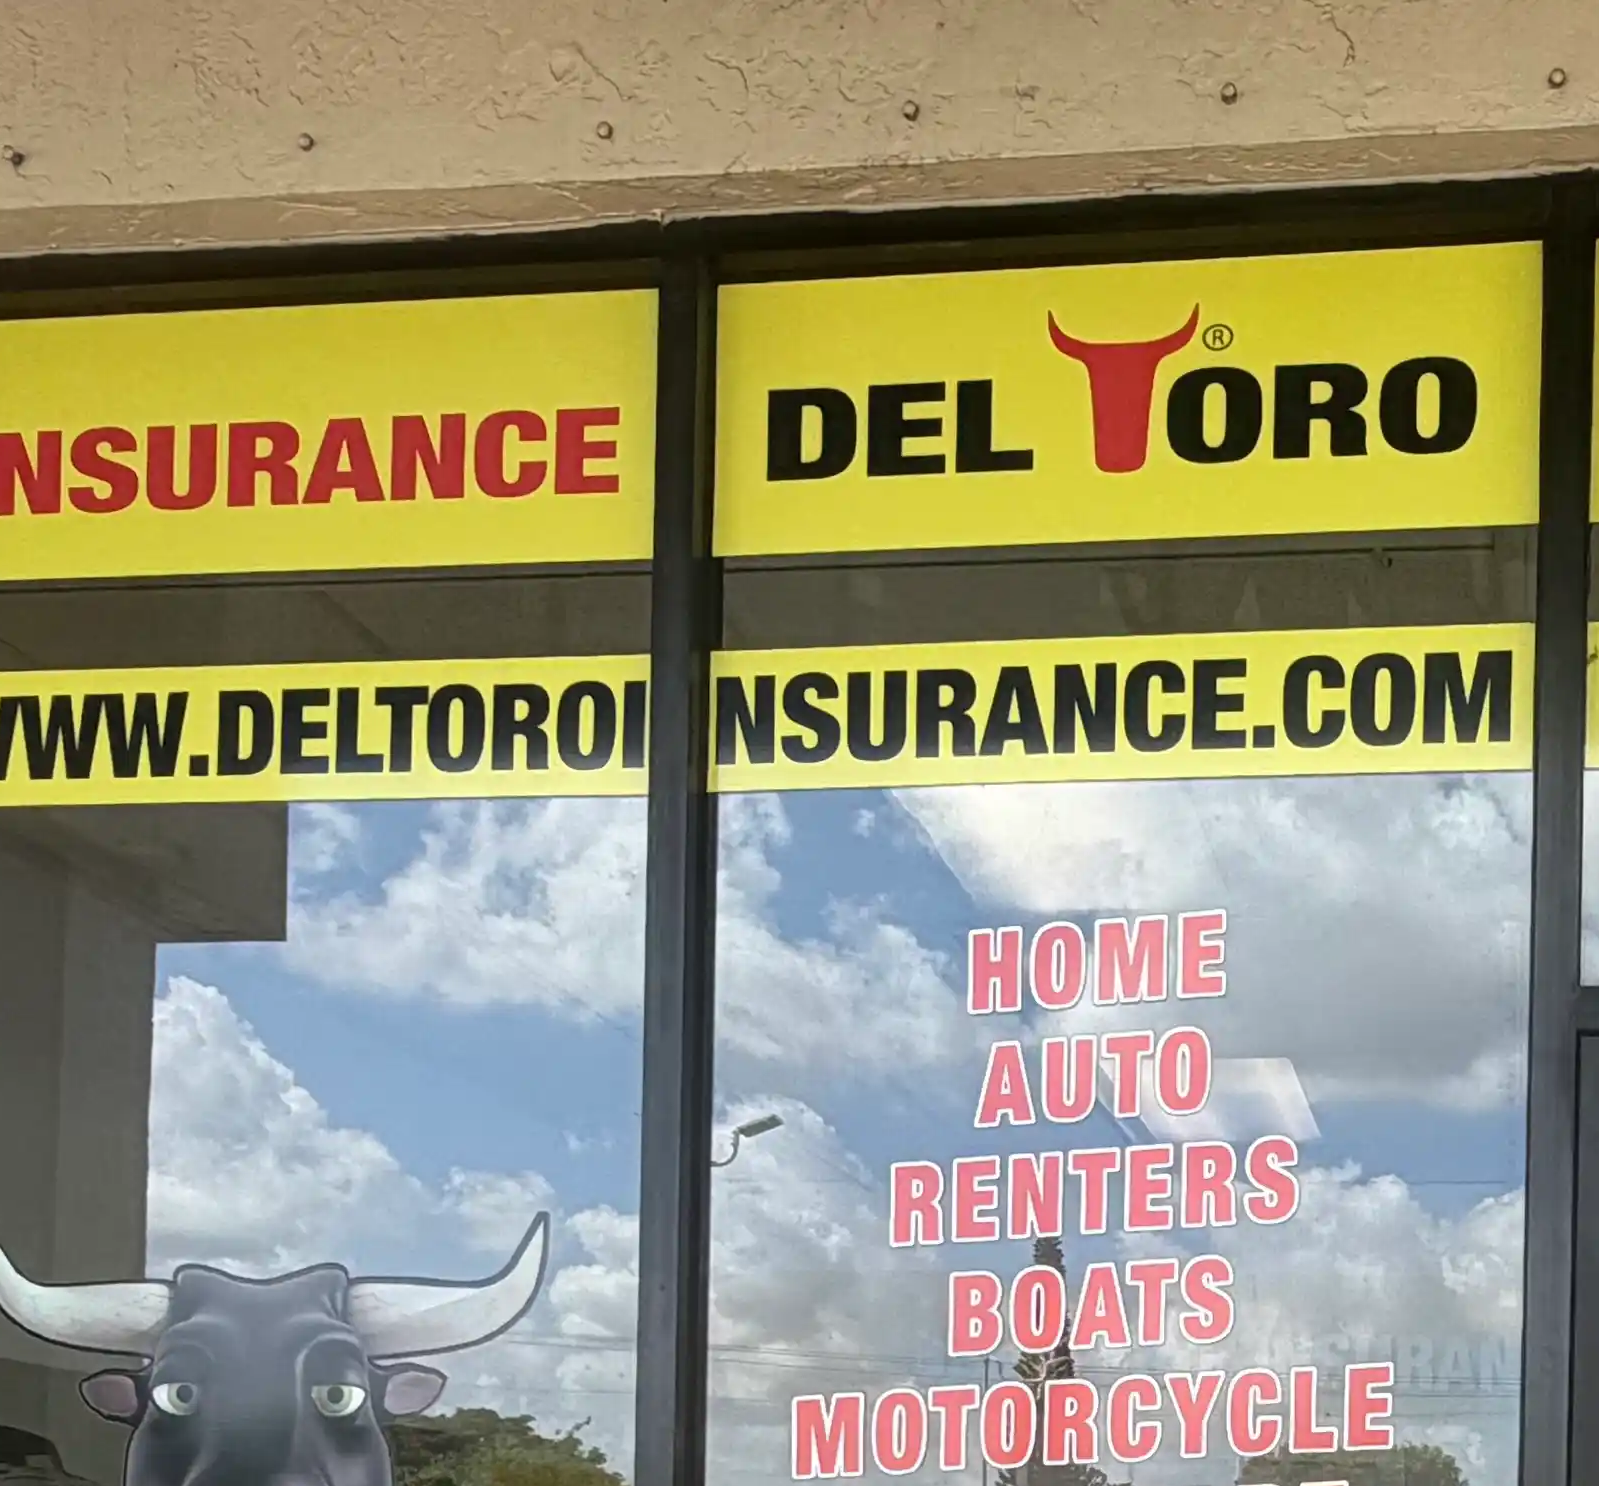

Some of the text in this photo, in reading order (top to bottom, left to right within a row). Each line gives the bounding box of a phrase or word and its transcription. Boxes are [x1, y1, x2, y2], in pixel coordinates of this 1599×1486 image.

[767, 379, 1034, 482] DEL
[967, 909, 1228, 1015] HOME
[974, 1026, 1212, 1129] AUTO
[889, 1135, 1299, 1248] RENTERS
[947, 1254, 1235, 1357] BOATS
[791, 1361, 1394, 1480] MOTORCYCLE
